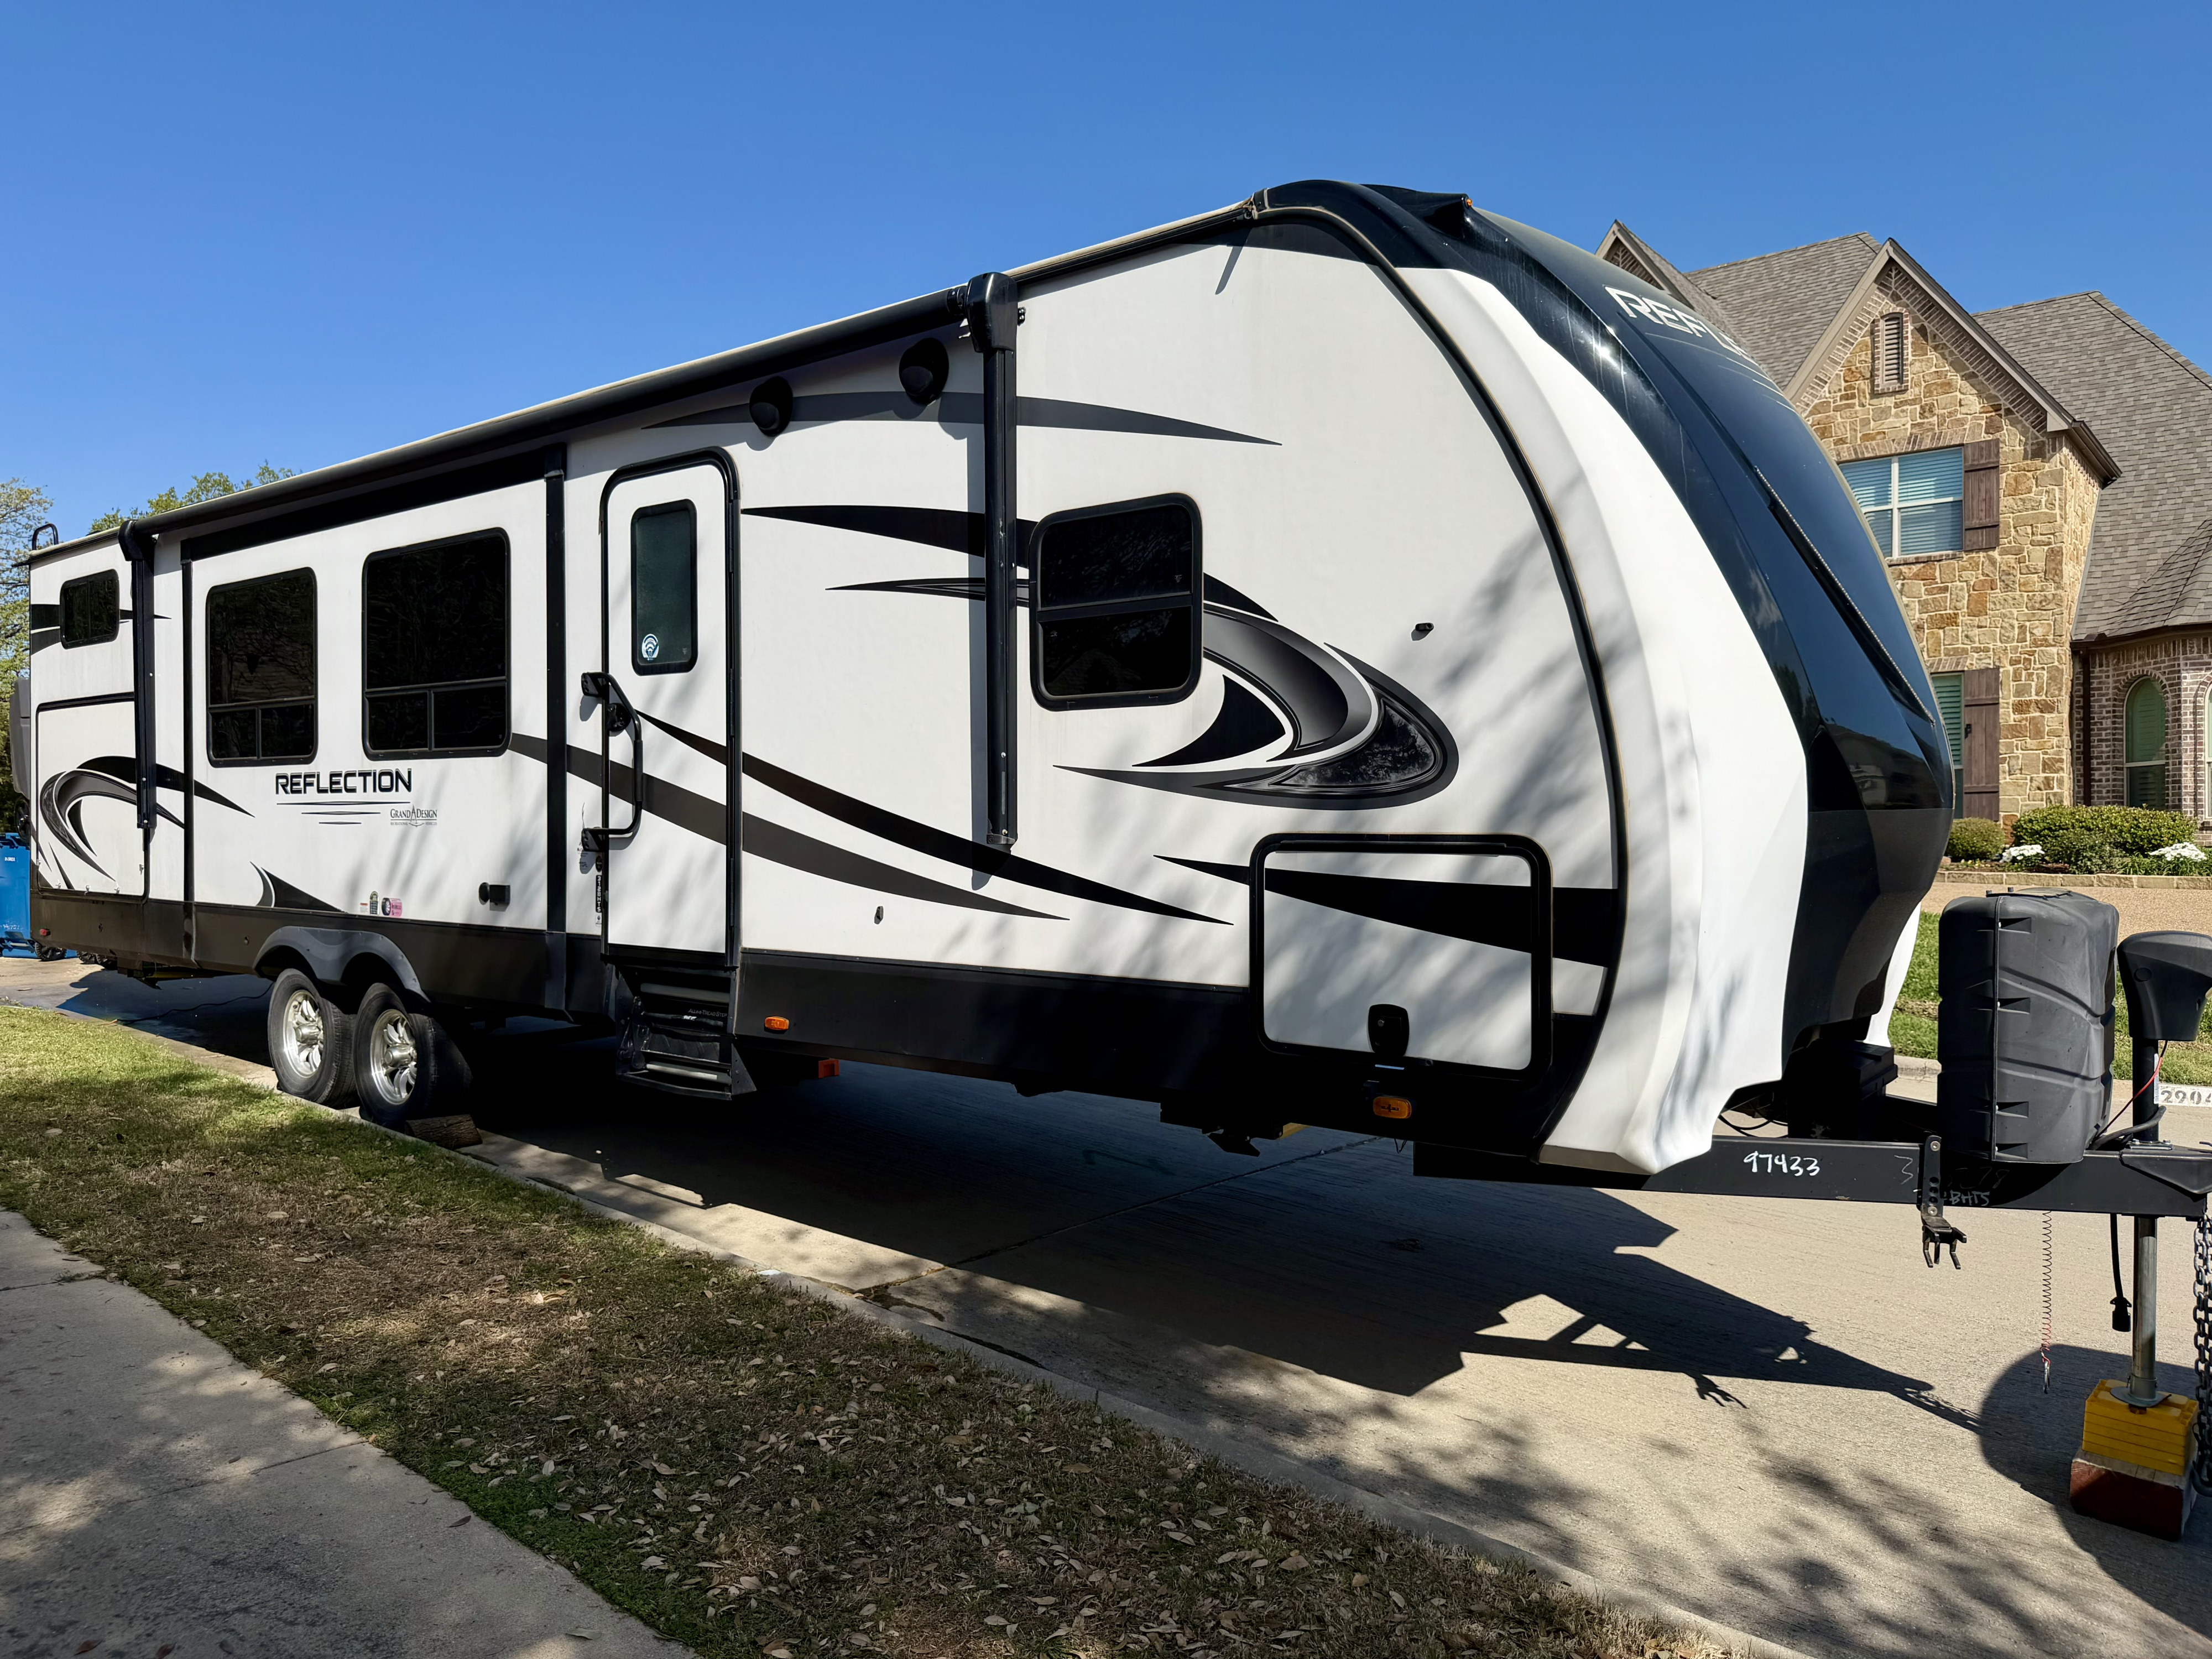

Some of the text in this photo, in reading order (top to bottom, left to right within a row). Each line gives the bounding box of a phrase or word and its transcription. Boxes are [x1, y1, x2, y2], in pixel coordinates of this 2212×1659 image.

[275, 768, 413, 795] REFLECTION
[390, 808, 437, 818] GRAND DESIGN
[1743, 1151, 1820, 1177] 97433
